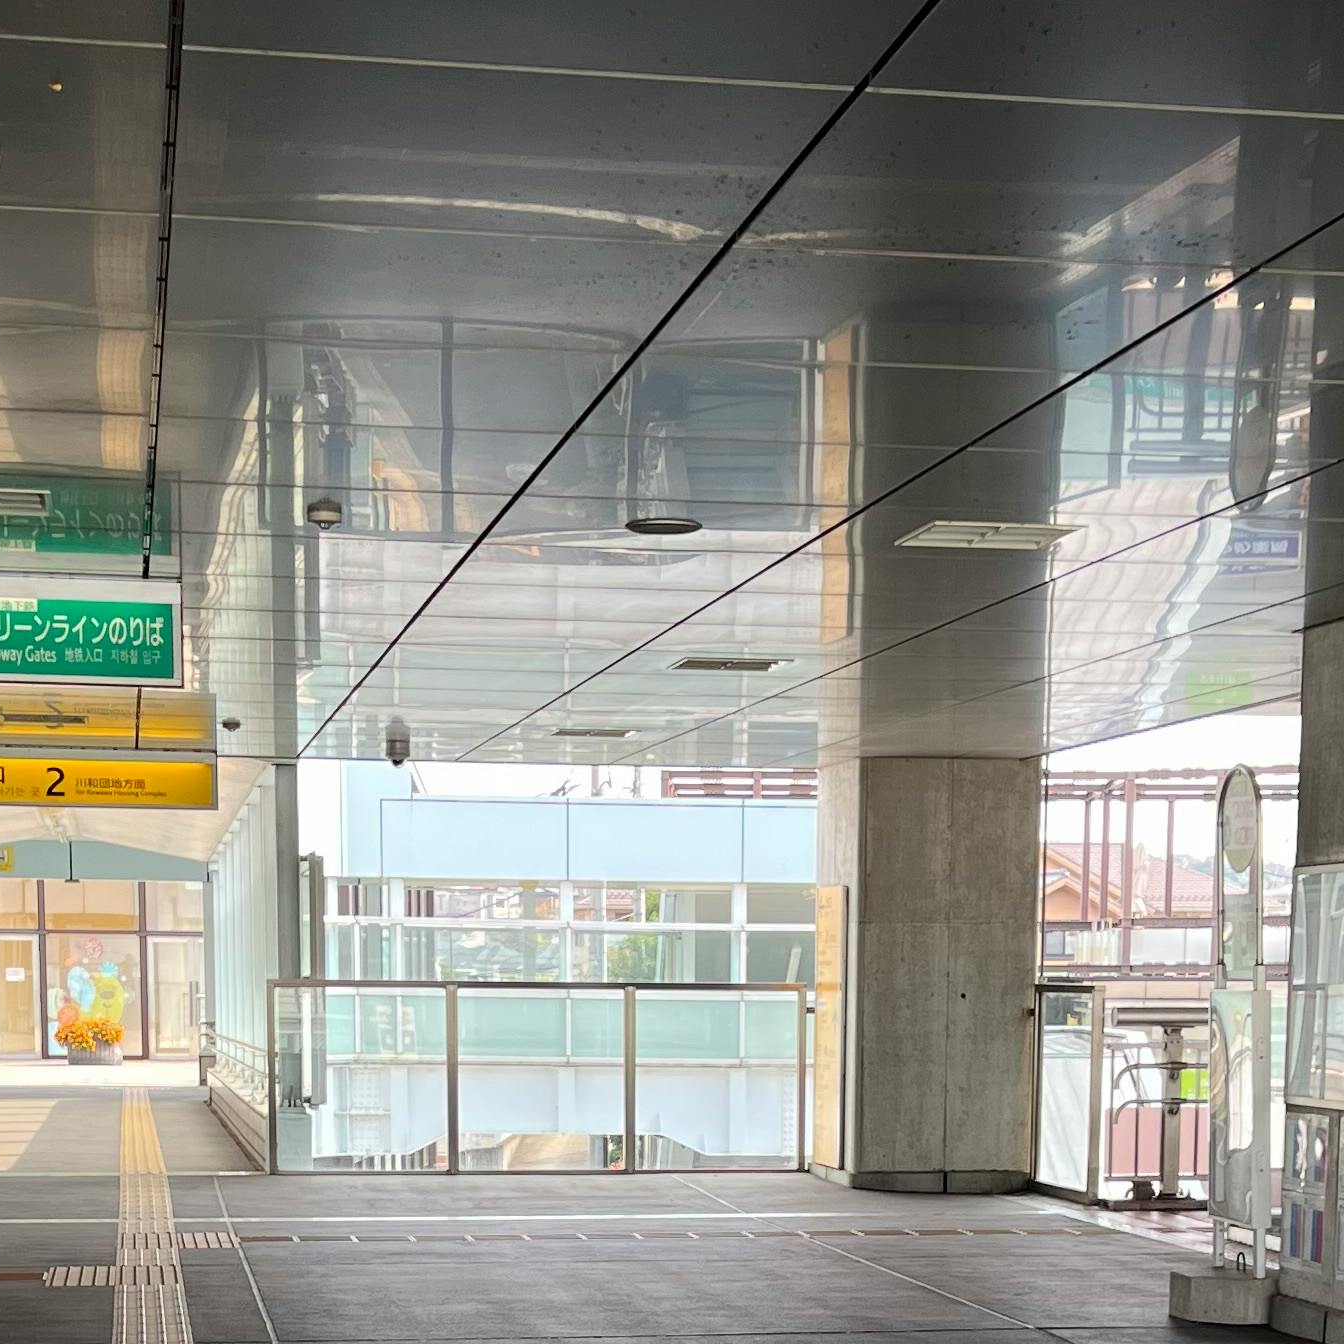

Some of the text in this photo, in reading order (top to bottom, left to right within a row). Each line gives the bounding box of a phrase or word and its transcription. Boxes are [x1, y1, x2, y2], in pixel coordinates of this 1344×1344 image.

[25, 645, 56, 664] Gates
[46, 767, 66, 797] 2
[75, 778, 146, 790] 川和団地方面
